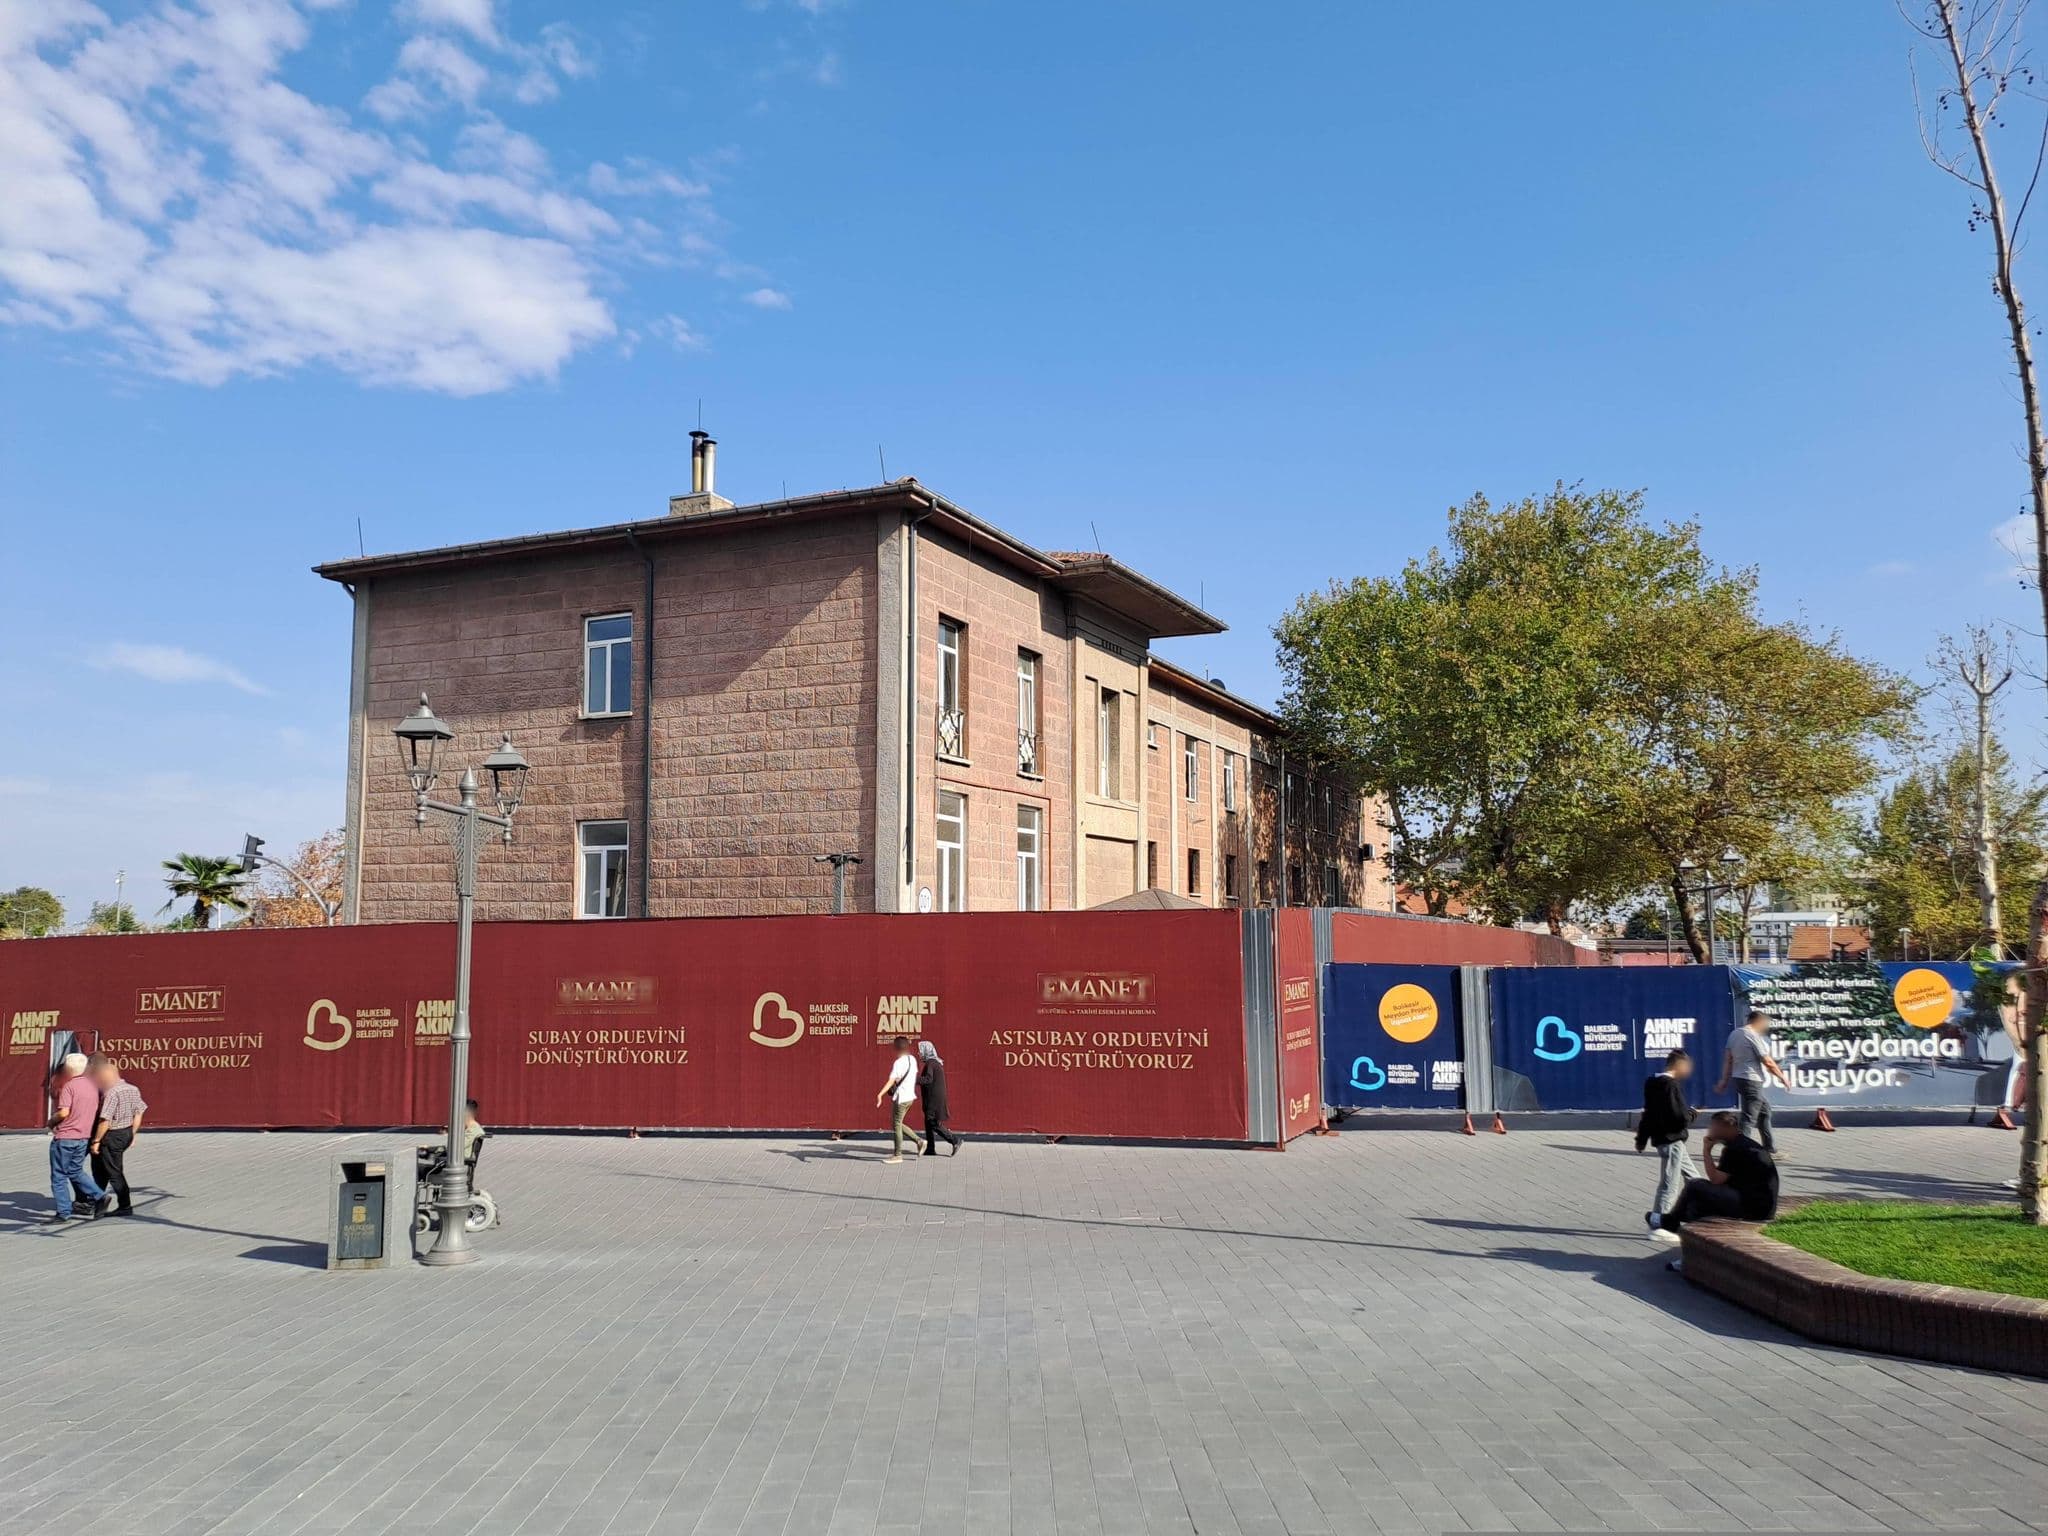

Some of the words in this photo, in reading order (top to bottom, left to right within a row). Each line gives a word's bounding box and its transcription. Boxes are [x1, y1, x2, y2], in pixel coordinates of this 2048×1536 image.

[1749, 979, 1772, 988] Salih
[1805, 978, 1834, 988] Kültür
[1285, 981, 1310, 1001] EMANET
[1749, 992, 1773, 1003] Şeyh
[1774, 991, 1819, 1001] Lütfullah
[140, 991, 222, 1011] EMANET
[415, 1000, 456, 1017] AHM
[809, 1002, 849, 1013] BALIKESİR
[877, 996, 939, 1014] AHMET
[356, 1007, 391, 1017] BALIKESİR
[1778, 1005, 1818, 1015] Orduevi
[11, 1010, 60, 1028] AHMET
[356, 1017, 399, 1029] BÜYÜKŞEHİR
[415, 1018, 455, 1034] AKIN
[809, 1013, 859, 1025] BÜYÜKŞEHİR
[877, 1015, 922, 1033] AKIN
[1644, 1018, 1696, 1033] AHMET
[1825, 1019, 1837, 1027] ve
[1838, 1018, 1861, 1027] Tren
[356, 1029, 394, 1038] BELEDİYESİ
[809, 1025, 853, 1035] BELEDİYESİ
[1584, 1023, 1619, 1032] BALIKESİR
[10, 1028, 46, 1045] AKIN
[99, 1036, 171, 1052] ASTSUBAY
[175, 1032, 264, 1051] ORDUEVİ'Nİ
[528, 1030, 582, 1045] SUBAY
[586, 1026, 686, 1044] ORDUEVİ'Nİ
[989, 1030, 1088, 1046] ASTSUBAY
[1092, 1028, 1209, 1047] ORDUEVİ'Nİ
[1584, 1032, 1628, 1042] BÜYÜKŞEHİR
[1645, 1033, 1683, 1049] AKIN
[1584, 1042, 1623, 1051] BELEDİYESİ
[1769, 1034, 1791, 1058] ir
[1797, 1032, 1963, 1064] meydanda
[525, 1047, 689, 1067] DÖNÜŞTÜRÜYORUZ
[1005, 1049, 1194, 1071] DÖNÜŞTÜRÜYORUZ
[1432, 1061, 1464, 1073] AHME
[1432, 1072, 1461, 1084] AKIN
